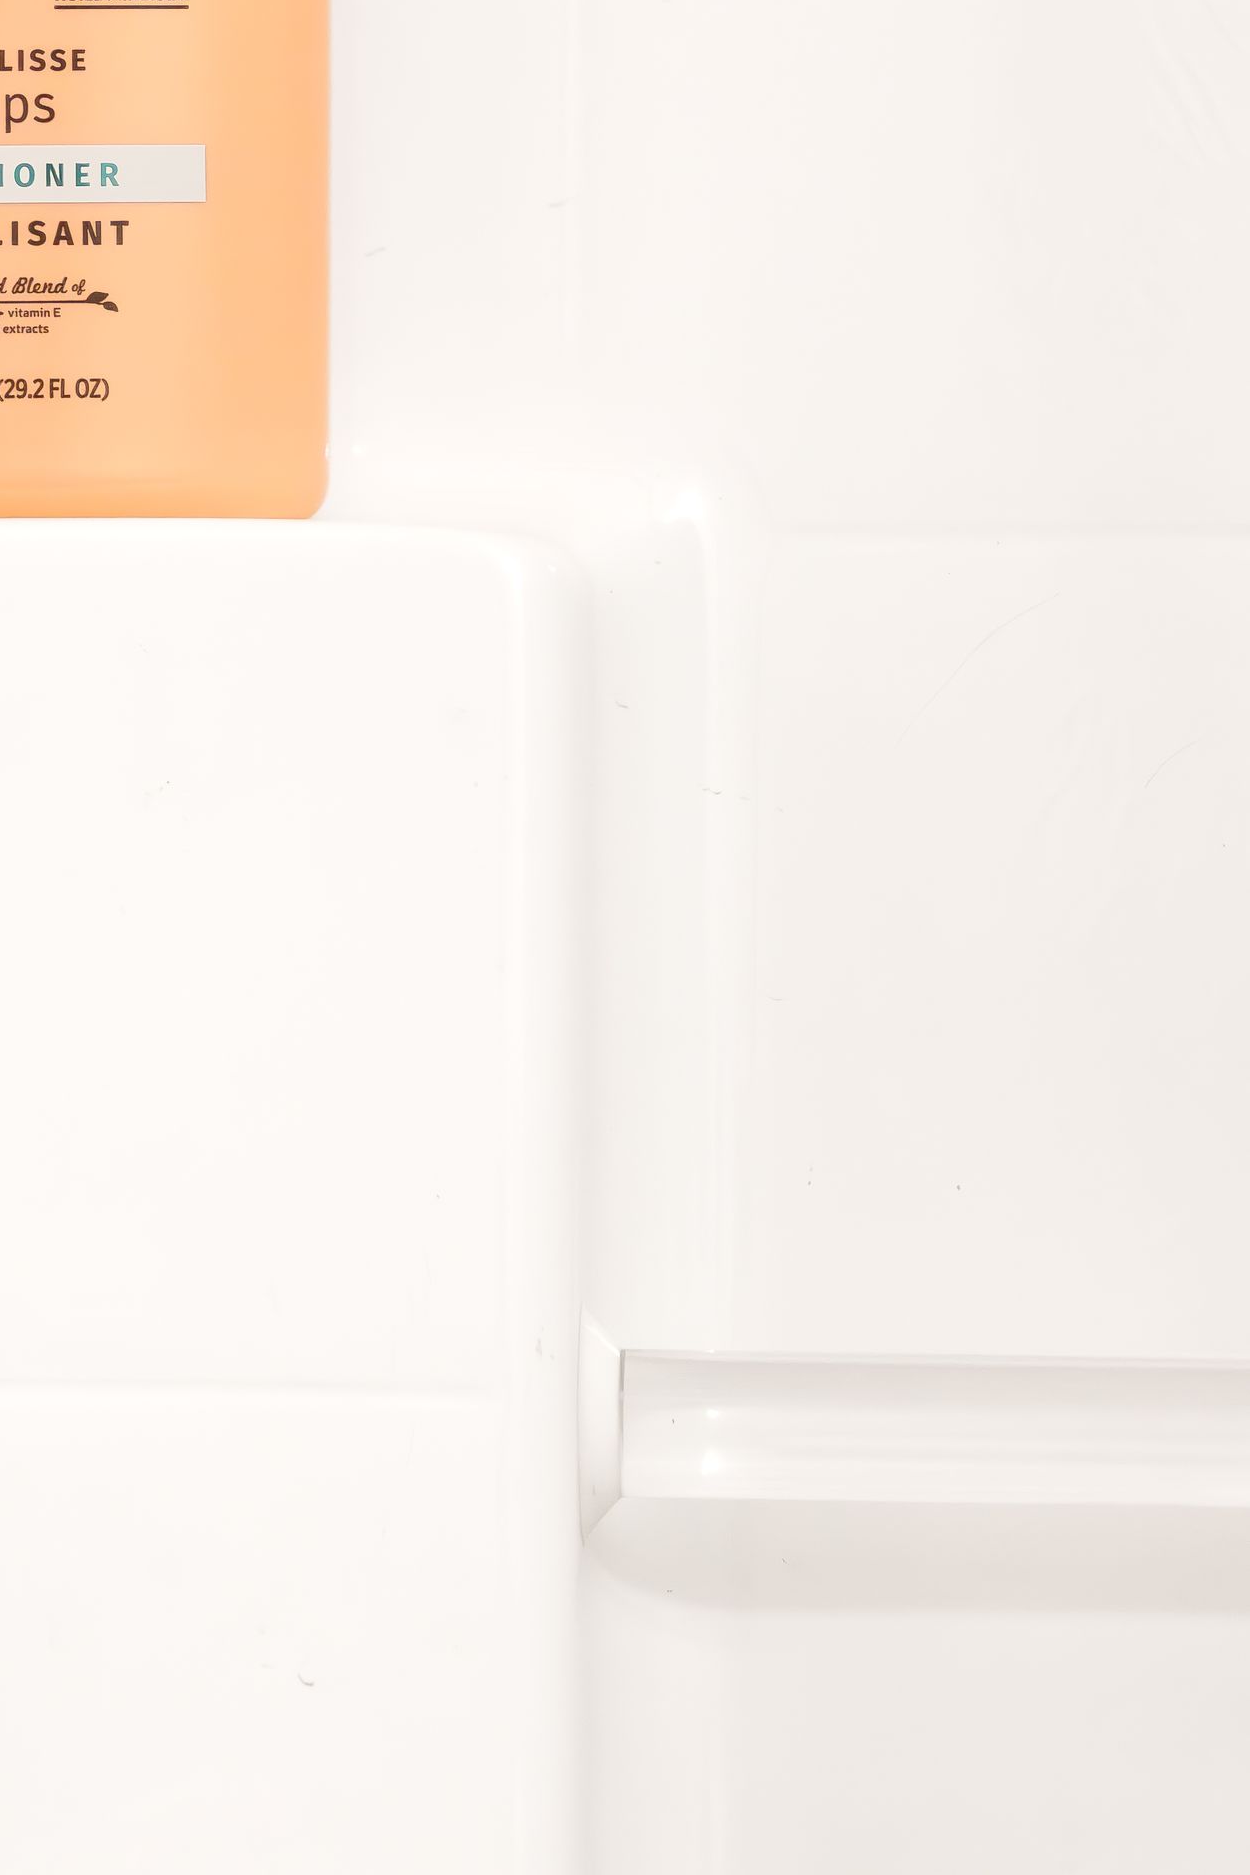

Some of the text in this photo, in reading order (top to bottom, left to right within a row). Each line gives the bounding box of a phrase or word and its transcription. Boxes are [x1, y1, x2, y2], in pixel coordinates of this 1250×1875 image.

[11, 276, 68, 294] Blend
[71, 279, 86, 296] of
[8, 308, 50, 318] vitamin
[53, 308, 61, 318] E
[3, 325, 49, 335] extracts
[49, 378, 71, 399] FL
[75, 378, 110, 402] OZ)
